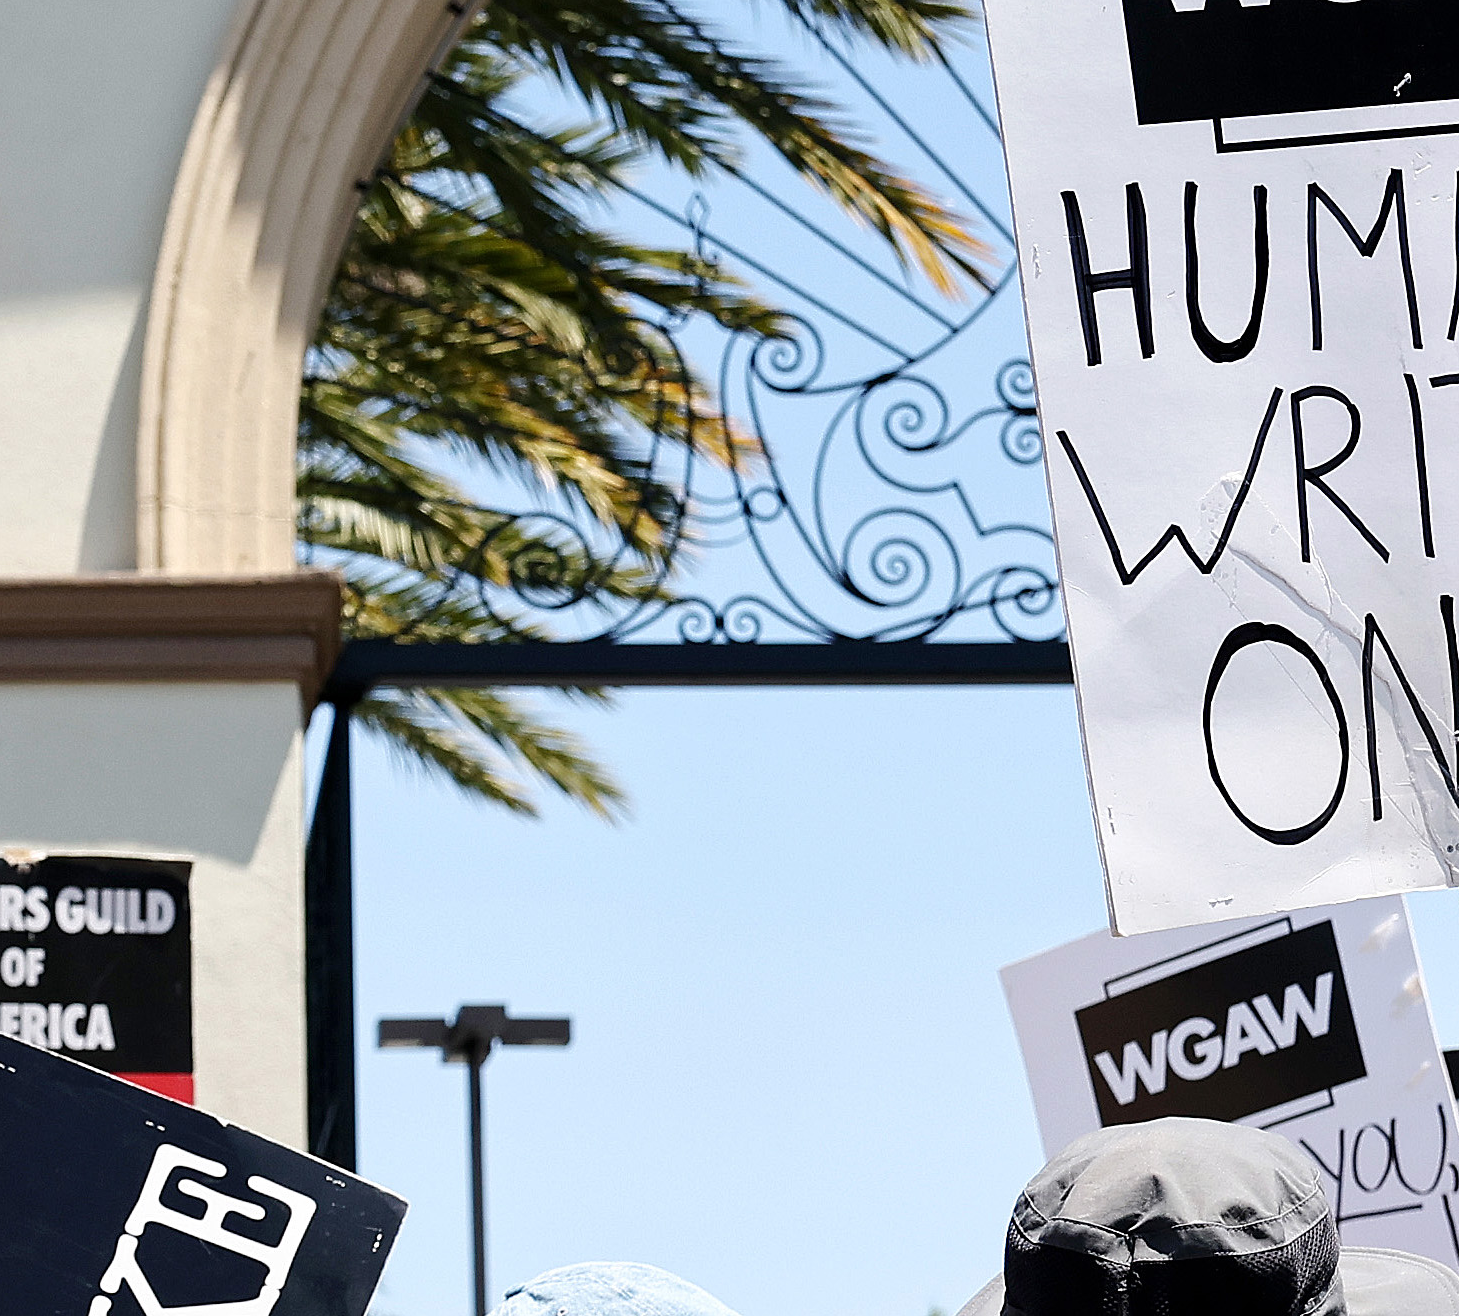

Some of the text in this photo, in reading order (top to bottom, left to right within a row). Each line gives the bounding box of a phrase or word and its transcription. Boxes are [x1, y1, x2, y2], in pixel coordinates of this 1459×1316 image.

[55, 888, 175, 934] GUILD
[0, 947, 45, 986] OF
[1094, 970, 1334, 1105] WGAW
